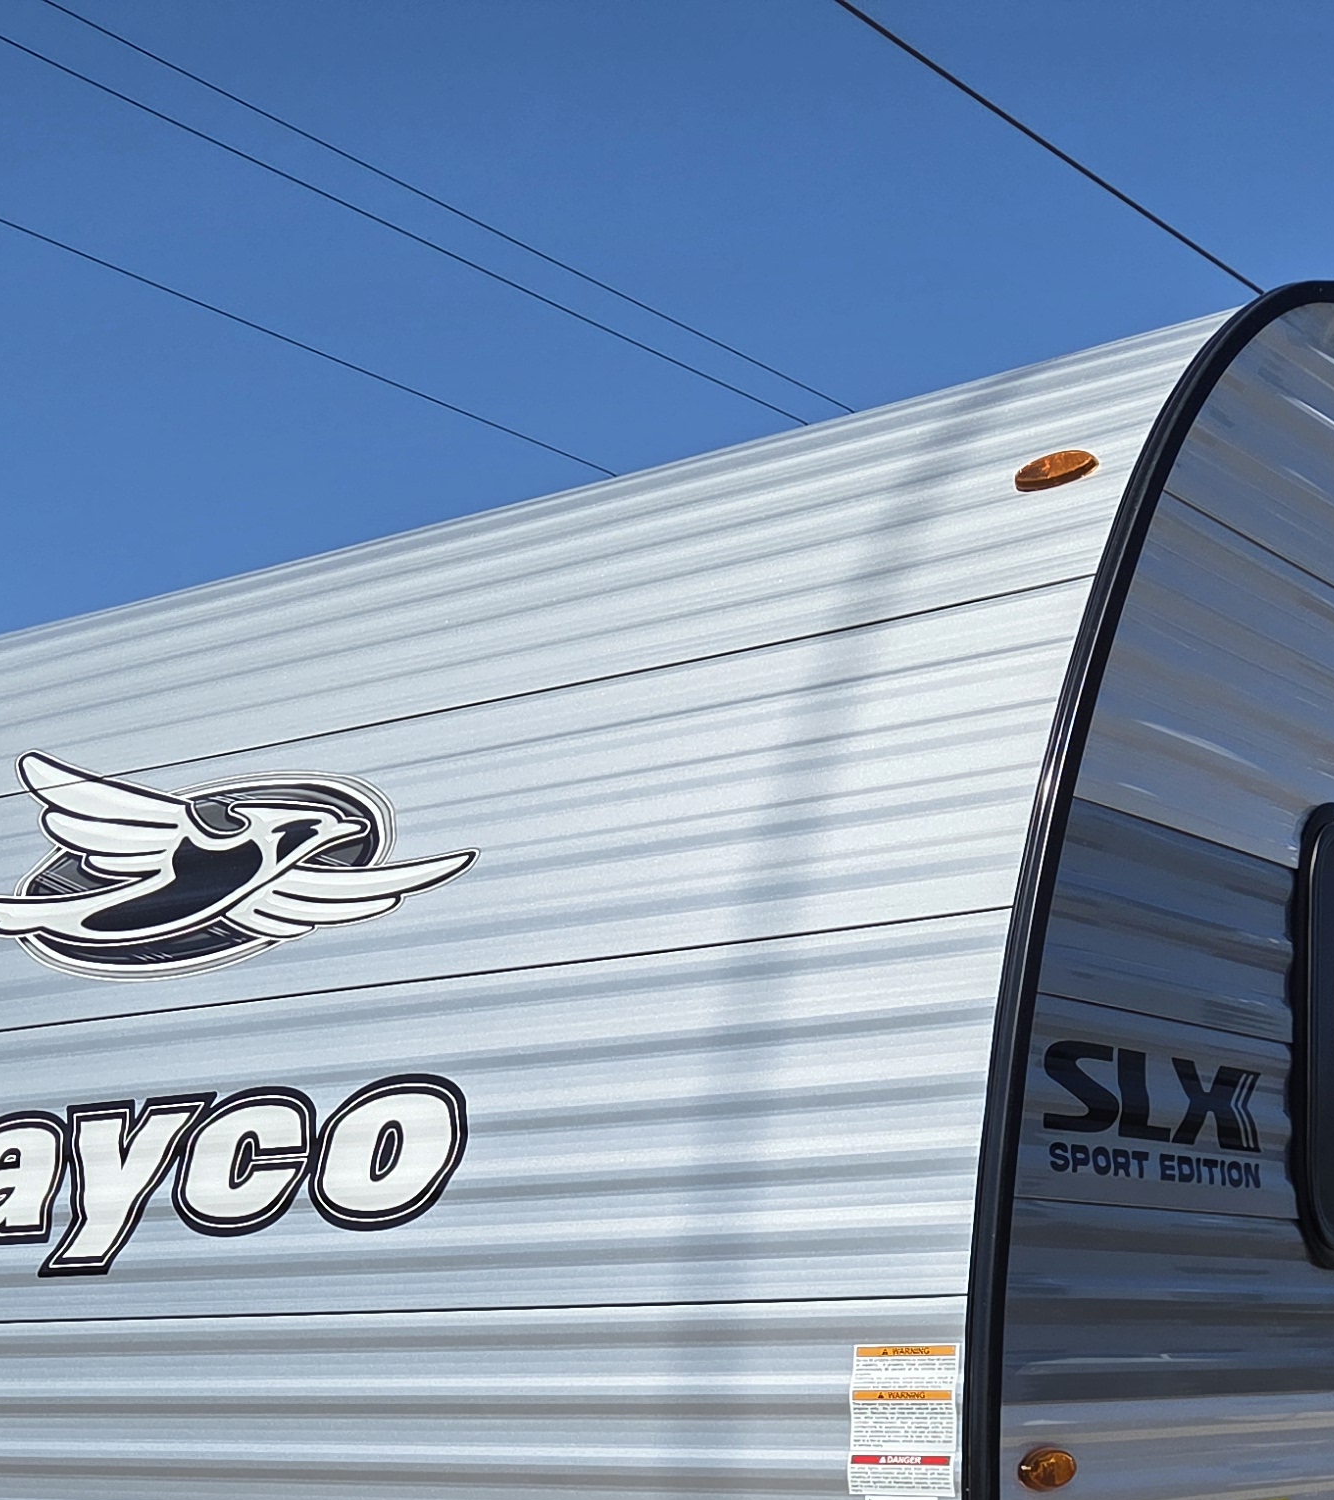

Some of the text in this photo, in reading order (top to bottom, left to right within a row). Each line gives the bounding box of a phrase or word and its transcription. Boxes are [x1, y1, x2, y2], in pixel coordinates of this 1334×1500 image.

[1043, 1040, 1262, 1153] SLX
[1049, 1143, 1262, 1189] SPORT EDITION
[892, 1347, 930, 1355] WARNING
[888, 1391, 926, 1399] WARNING
[887, 1456, 922, 1464] DANGER
